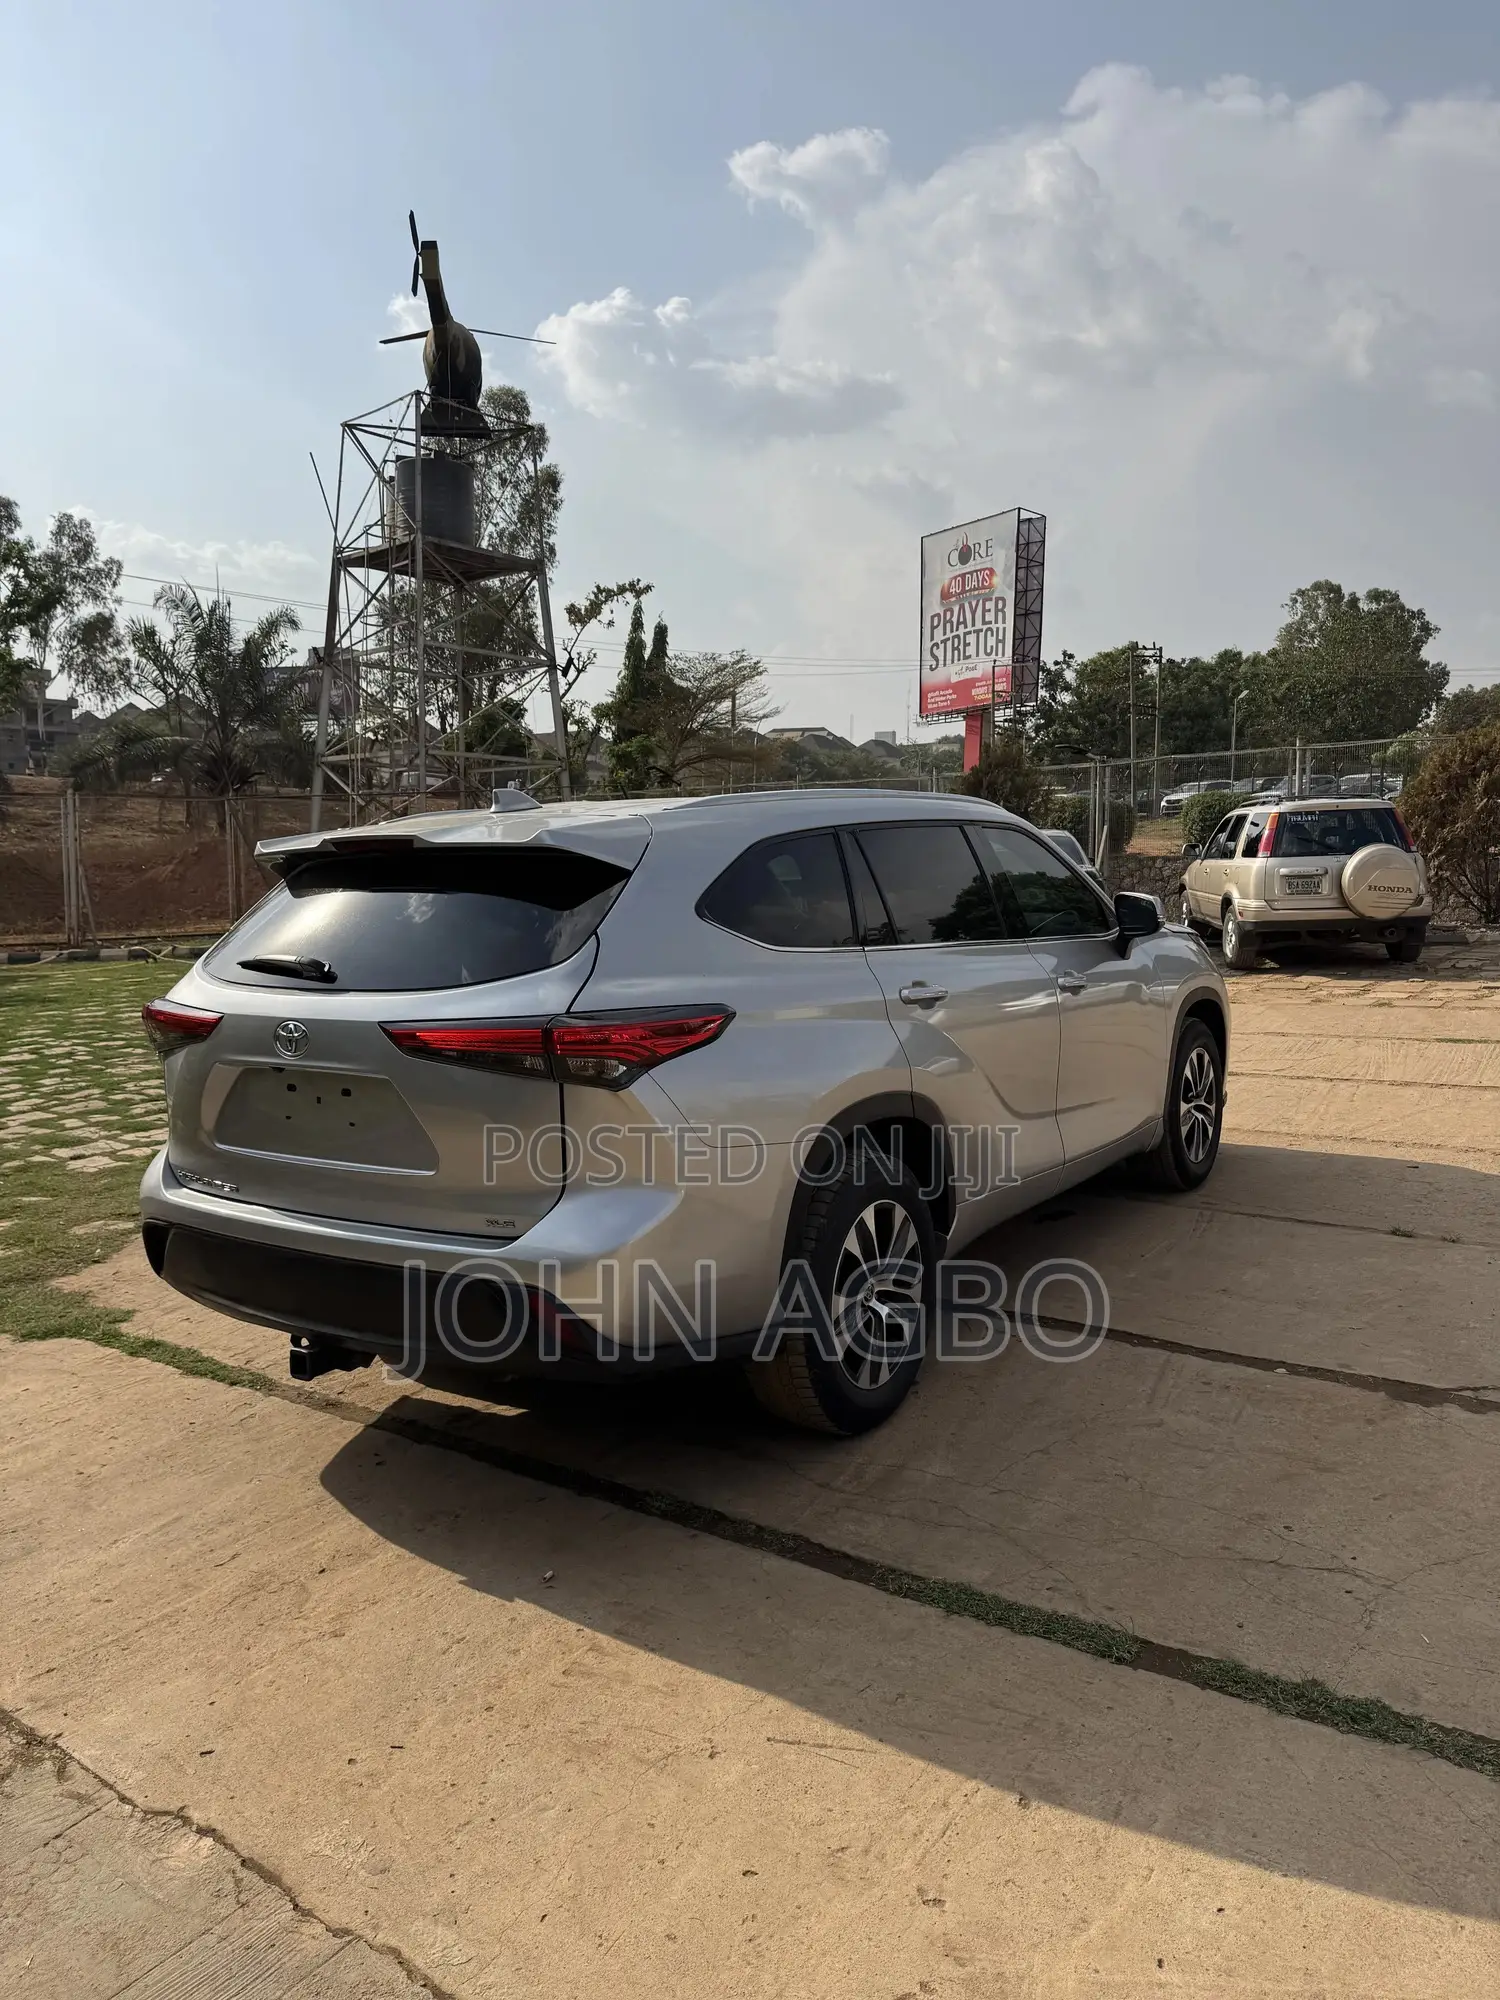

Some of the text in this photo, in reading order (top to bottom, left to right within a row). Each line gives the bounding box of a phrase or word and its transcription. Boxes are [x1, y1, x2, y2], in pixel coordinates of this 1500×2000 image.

[949, 569, 990, 595] 40 DAYS
[930, 596, 1007, 642] PRAYER
[929, 626, 1007, 671] STRETCH
[1368, 885, 1413, 893] HONDA
